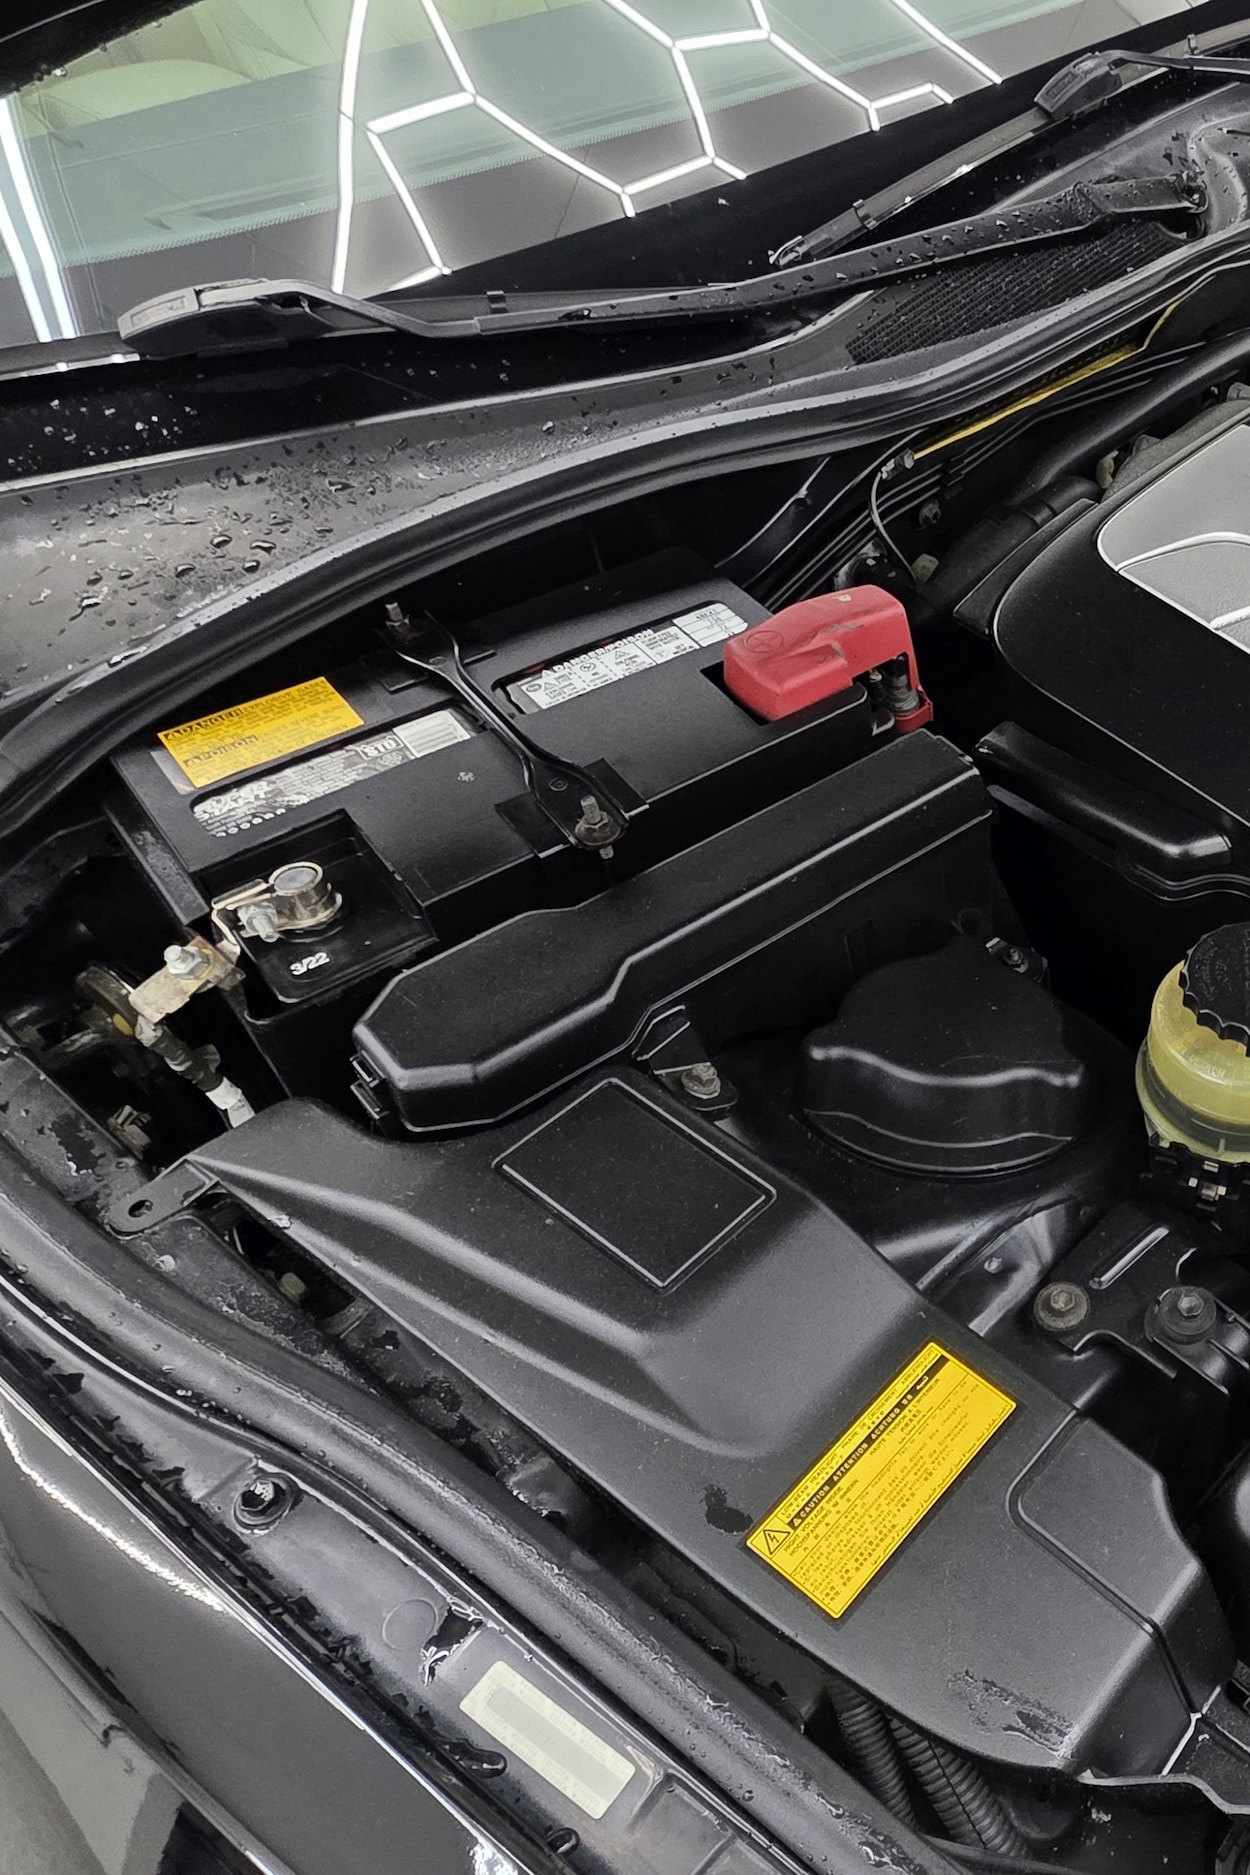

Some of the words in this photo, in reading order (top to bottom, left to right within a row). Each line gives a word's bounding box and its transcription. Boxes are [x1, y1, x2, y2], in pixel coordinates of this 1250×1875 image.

[289, 952, 330, 976] 3/22
[798, 1484, 831, 1518] CAUTION
[831, 1441, 869, 1482] ATTENTION
[869, 1406, 901, 1440] ACHTUNG
